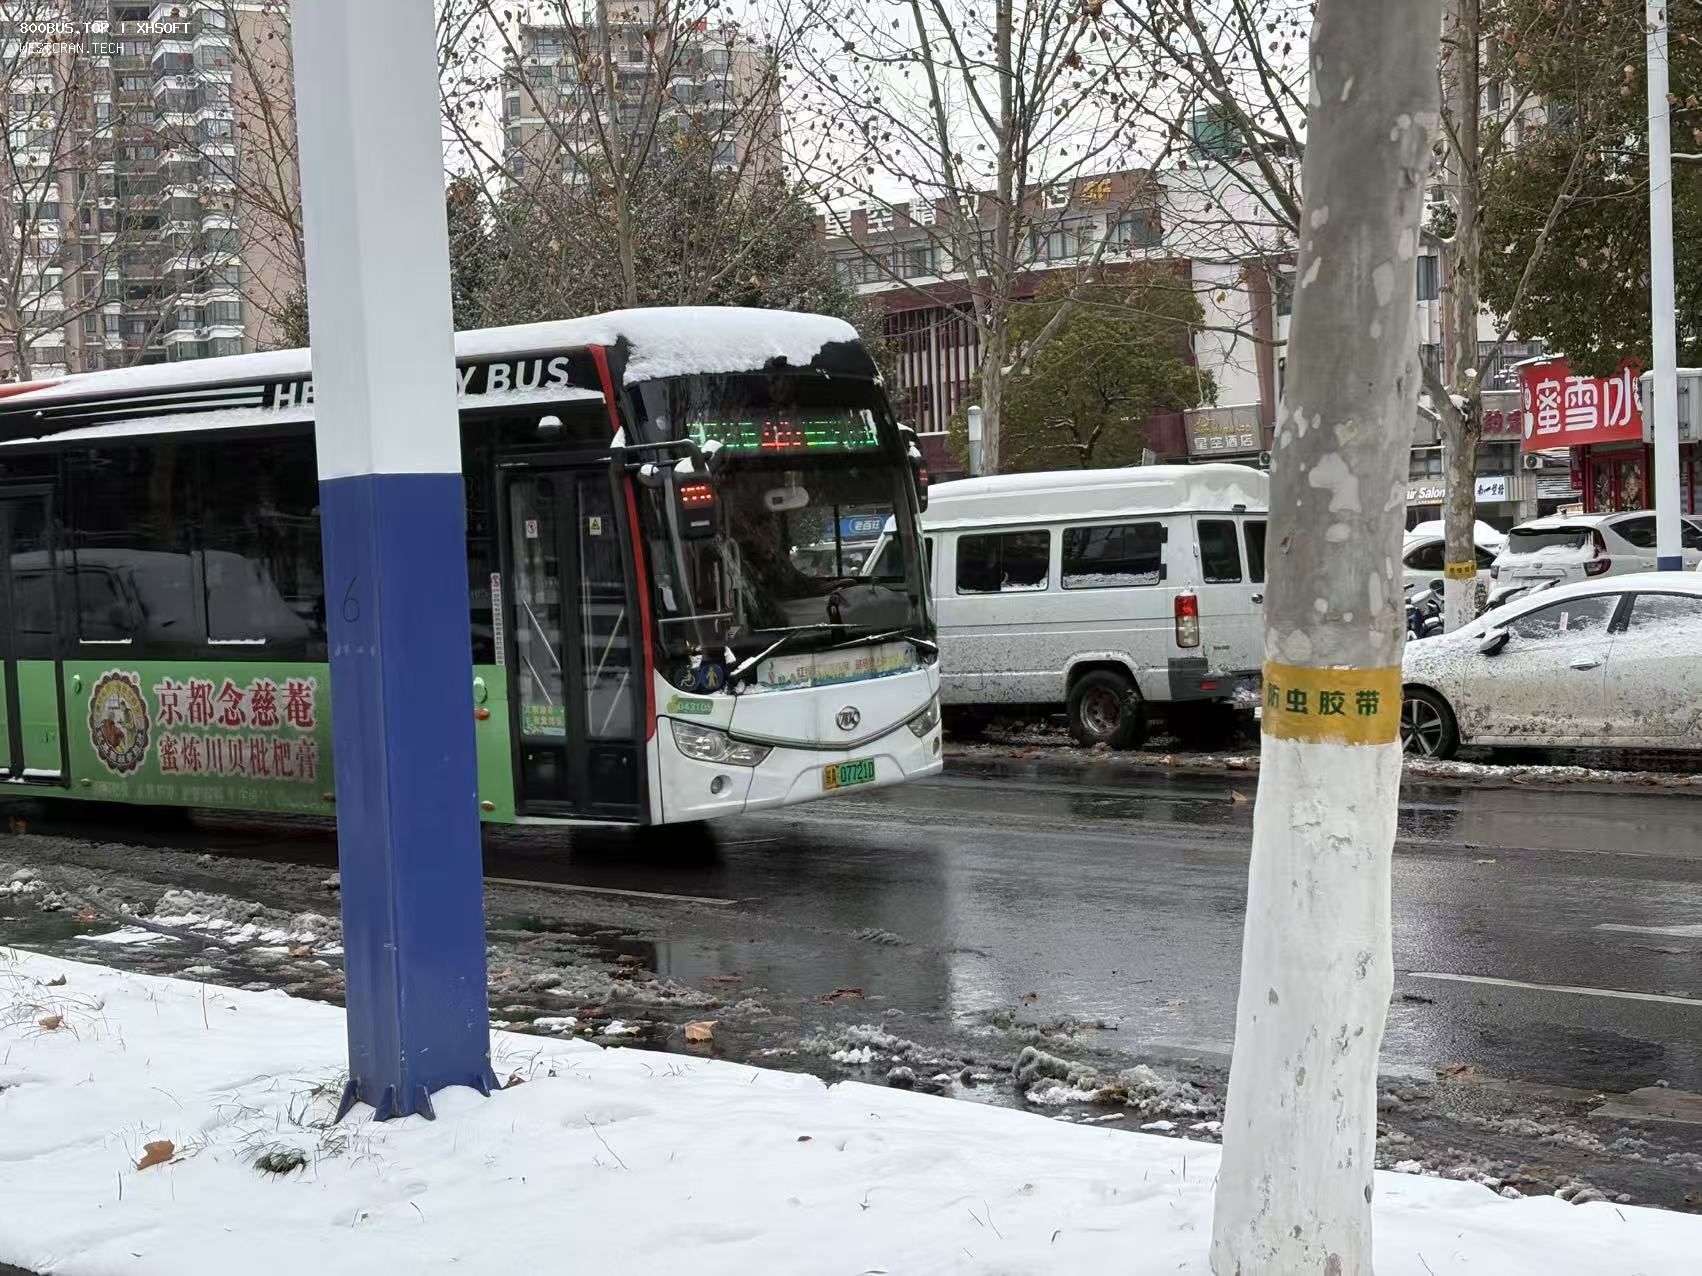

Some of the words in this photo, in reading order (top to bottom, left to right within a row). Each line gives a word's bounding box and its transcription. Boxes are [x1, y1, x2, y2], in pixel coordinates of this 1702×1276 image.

[485, 356, 570, 394] BUS
[1194, 434, 1253, 450] 星空酒店
[1418, 485, 1446, 499] Salon
[343, 575, 360, 623] 6
[155, 679, 317, 728] 京都念慈菴
[1266, 682, 1380, 716] 防虫胶带
[159, 734, 317, 779] 蜜炼川贝枇杷膏
